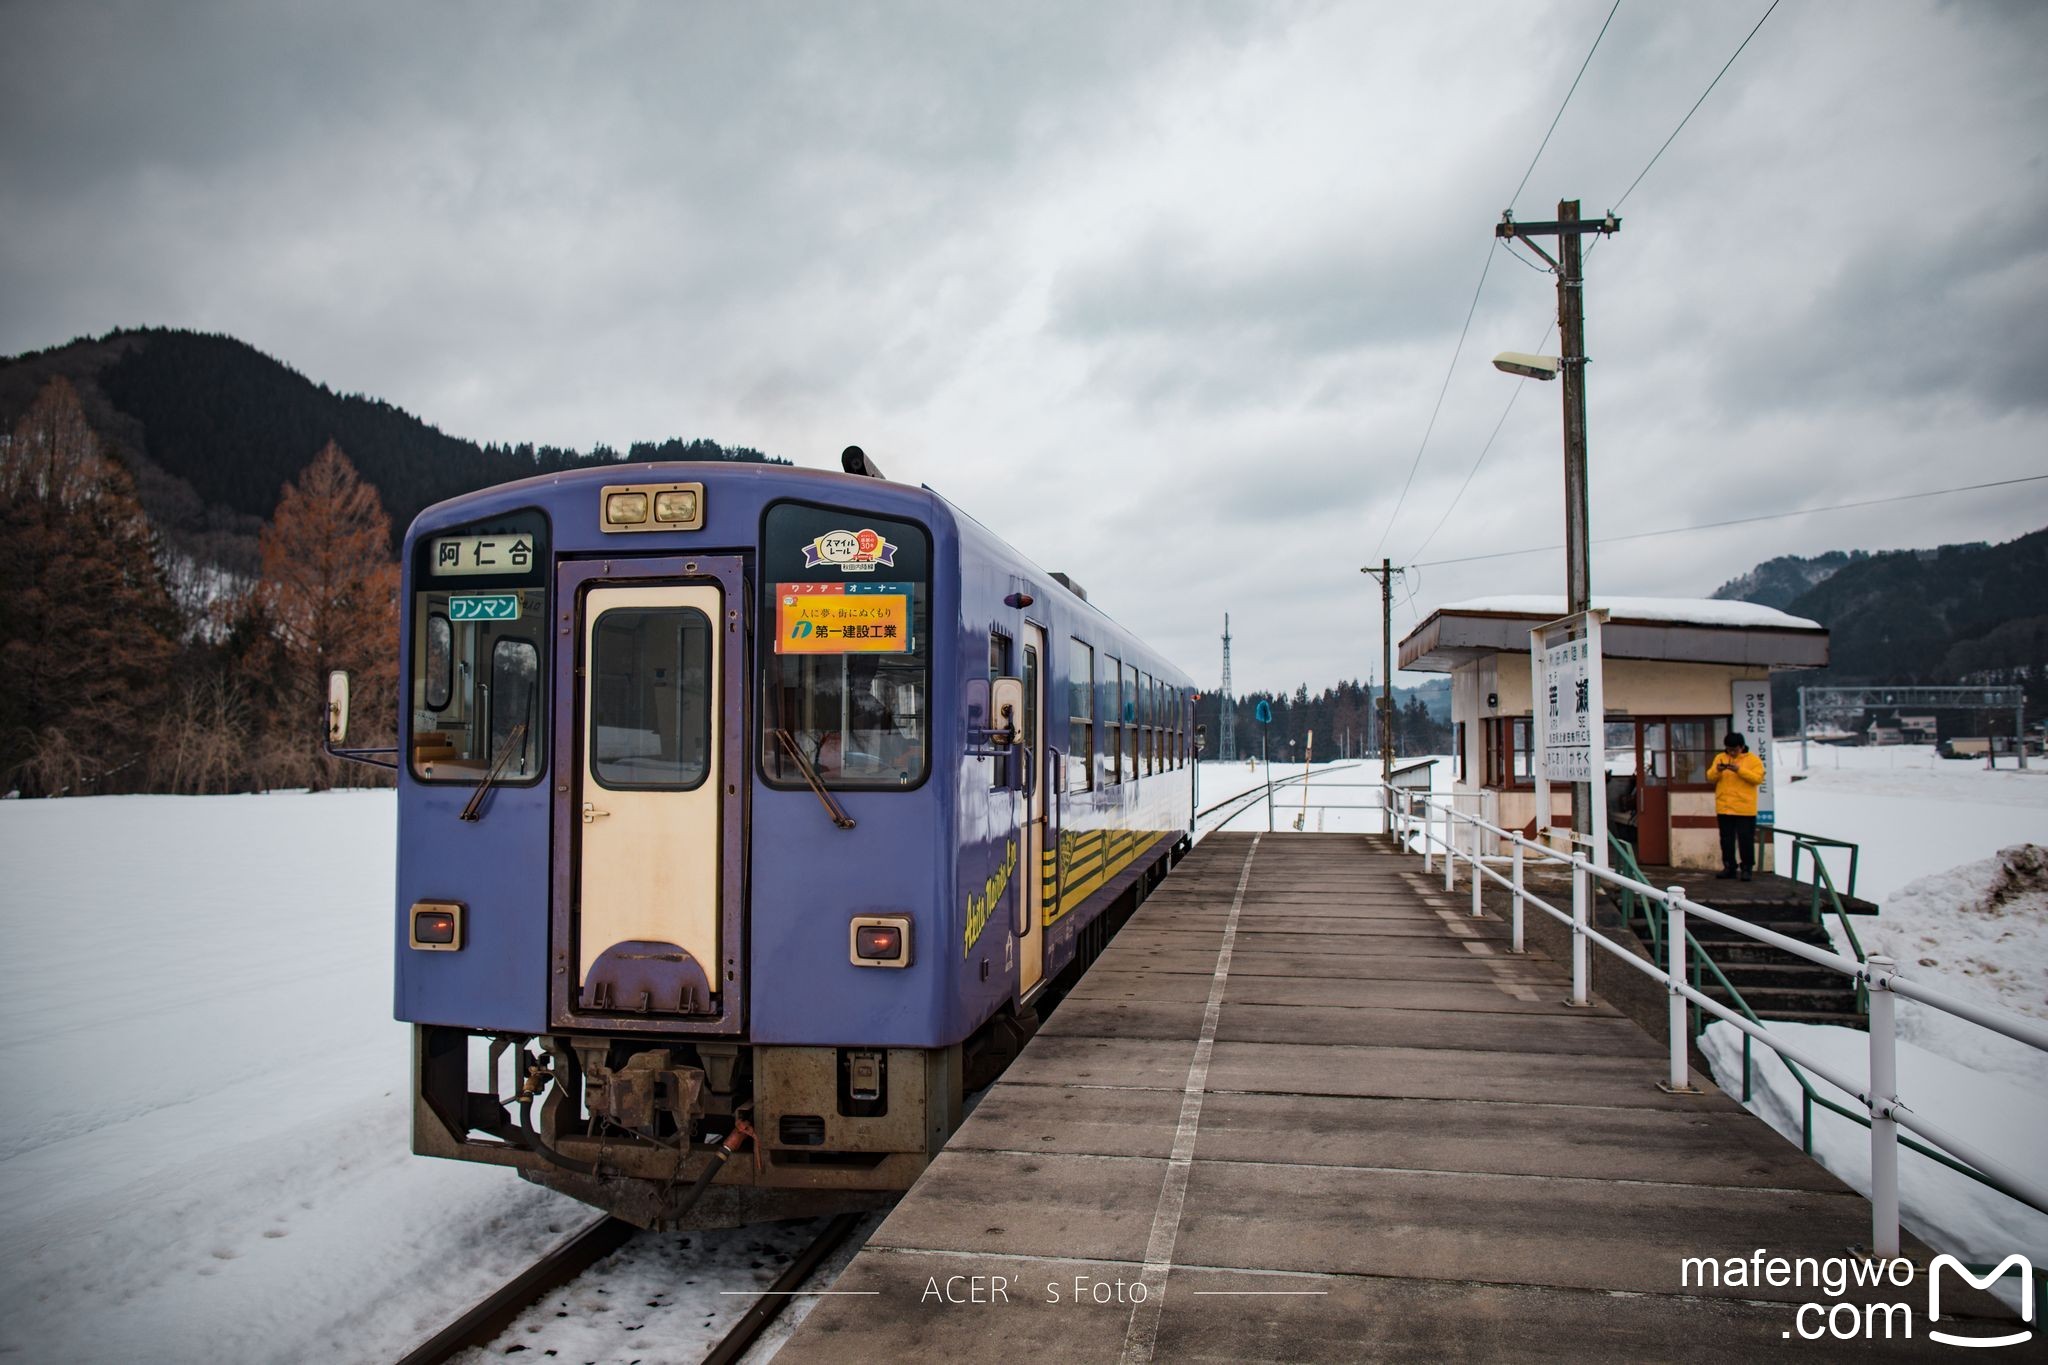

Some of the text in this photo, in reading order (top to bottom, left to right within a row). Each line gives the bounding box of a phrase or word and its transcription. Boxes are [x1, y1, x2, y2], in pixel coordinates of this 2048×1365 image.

[826, 539, 856, 548] スマイル
[438, 539, 532, 567] 阿仁合
[451, 598, 515, 618] ワンマン
[801, 608, 892, 618] 人に夢、街にぬくもり
[815, 625, 897, 638] 第一建設工業
